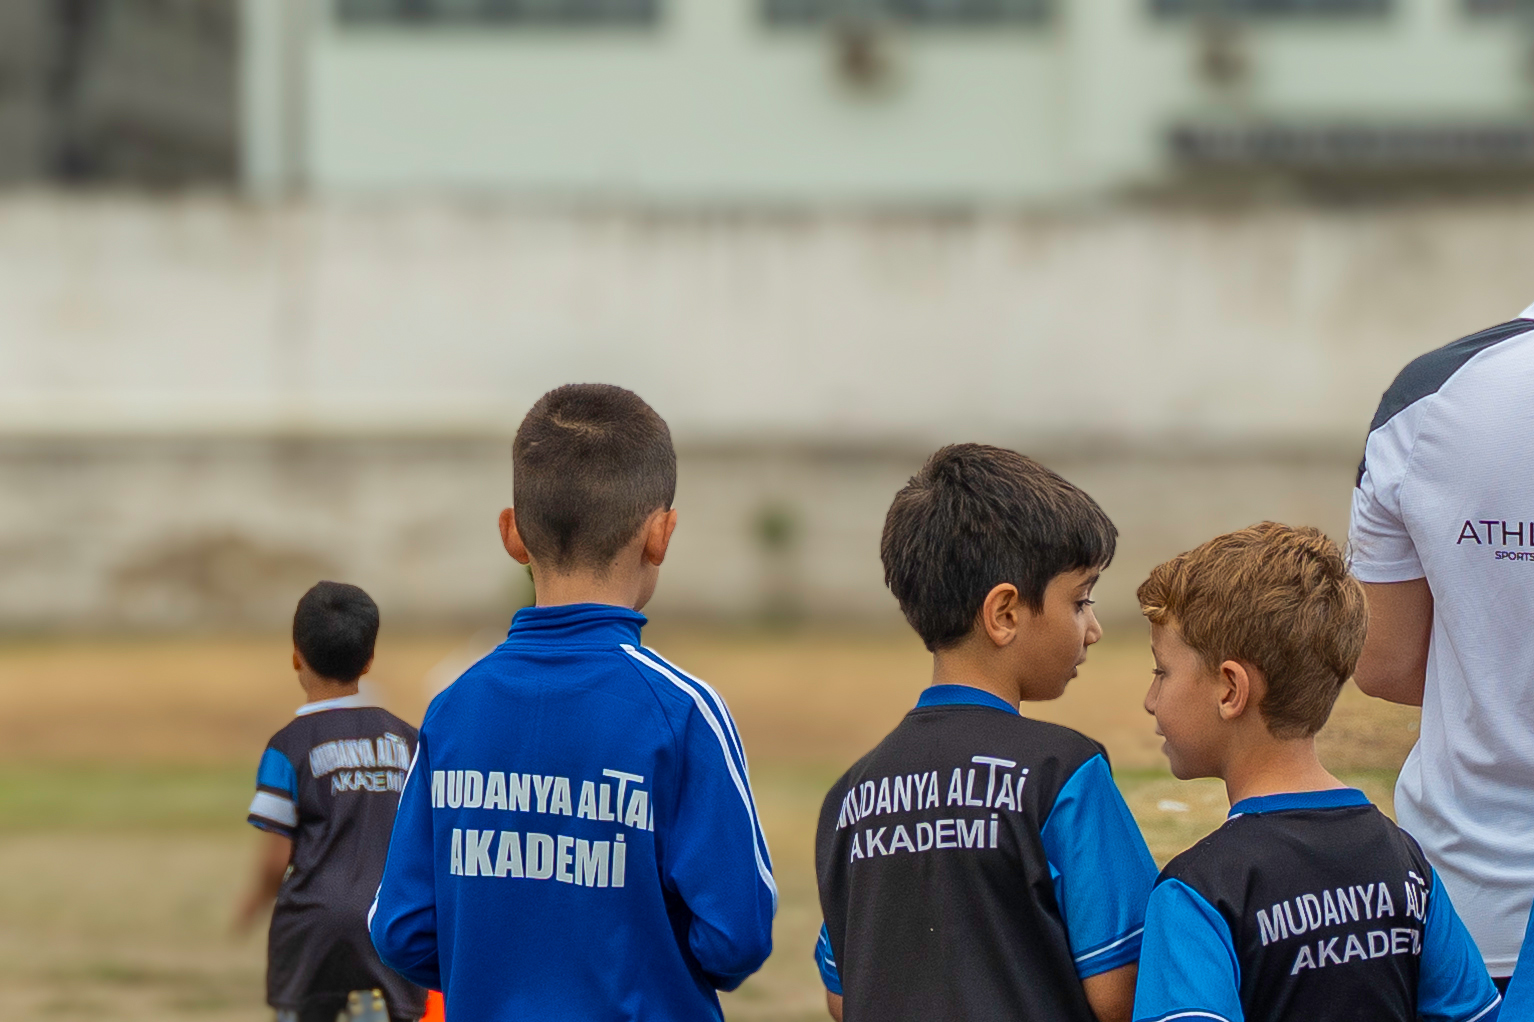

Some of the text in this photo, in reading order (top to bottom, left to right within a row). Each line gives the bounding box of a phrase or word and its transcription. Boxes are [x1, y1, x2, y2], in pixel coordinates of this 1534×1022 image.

[577, 768, 655, 832] ALTA
[450, 827, 627, 888] AKADEMİ
[850, 813, 999, 864] AKADEMİ
[1256, 881, 1395, 947] MUDANYA
